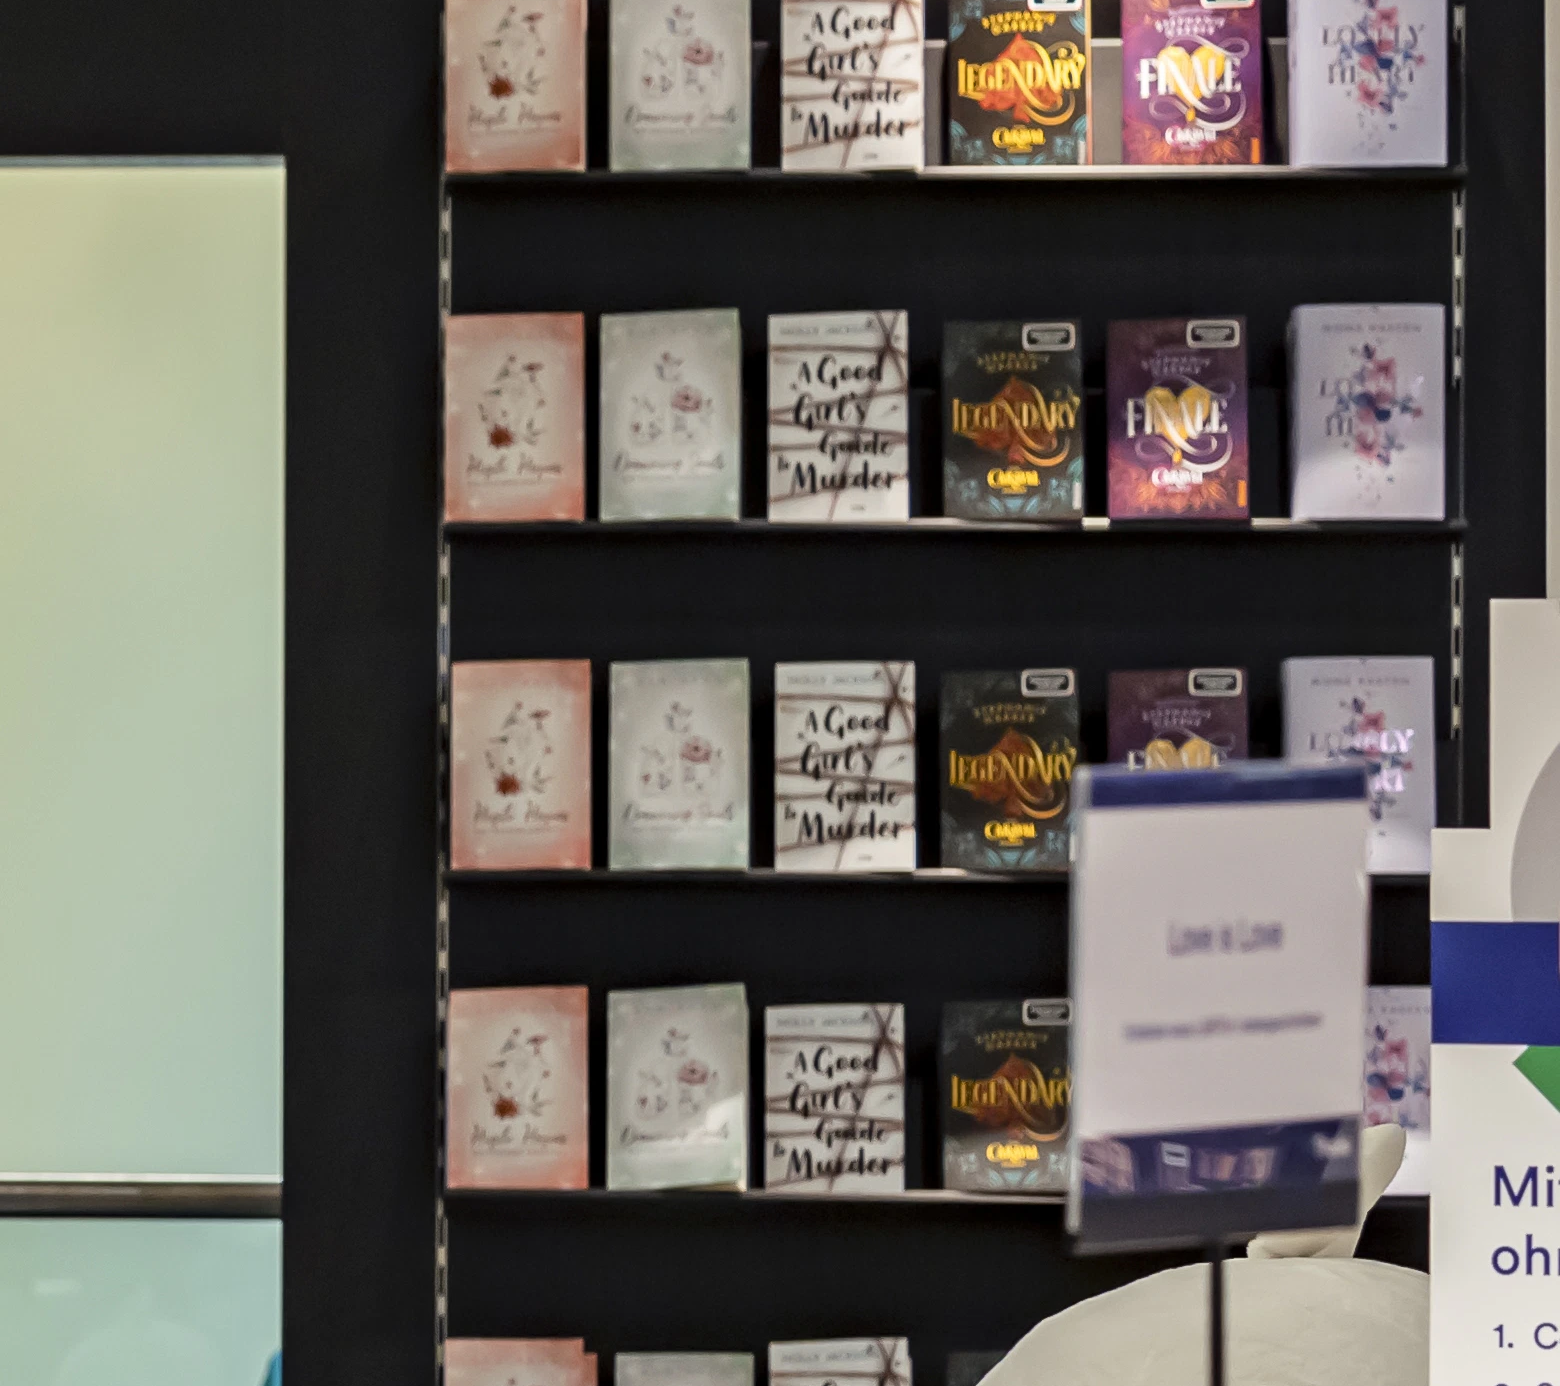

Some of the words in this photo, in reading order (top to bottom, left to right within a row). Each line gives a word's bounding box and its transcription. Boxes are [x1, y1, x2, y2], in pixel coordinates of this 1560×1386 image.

[831, 4, 896, 40] Good
[808, 41, 879, 81] Girl's
[832, 80, 902, 111] Guide
[808, 109, 905, 144] Murder
[1494, 1165, 1560, 1207] Mi
[1491, 1233, 1560, 1276] oh
[1493, 1324, 1514, 1348] 1.
